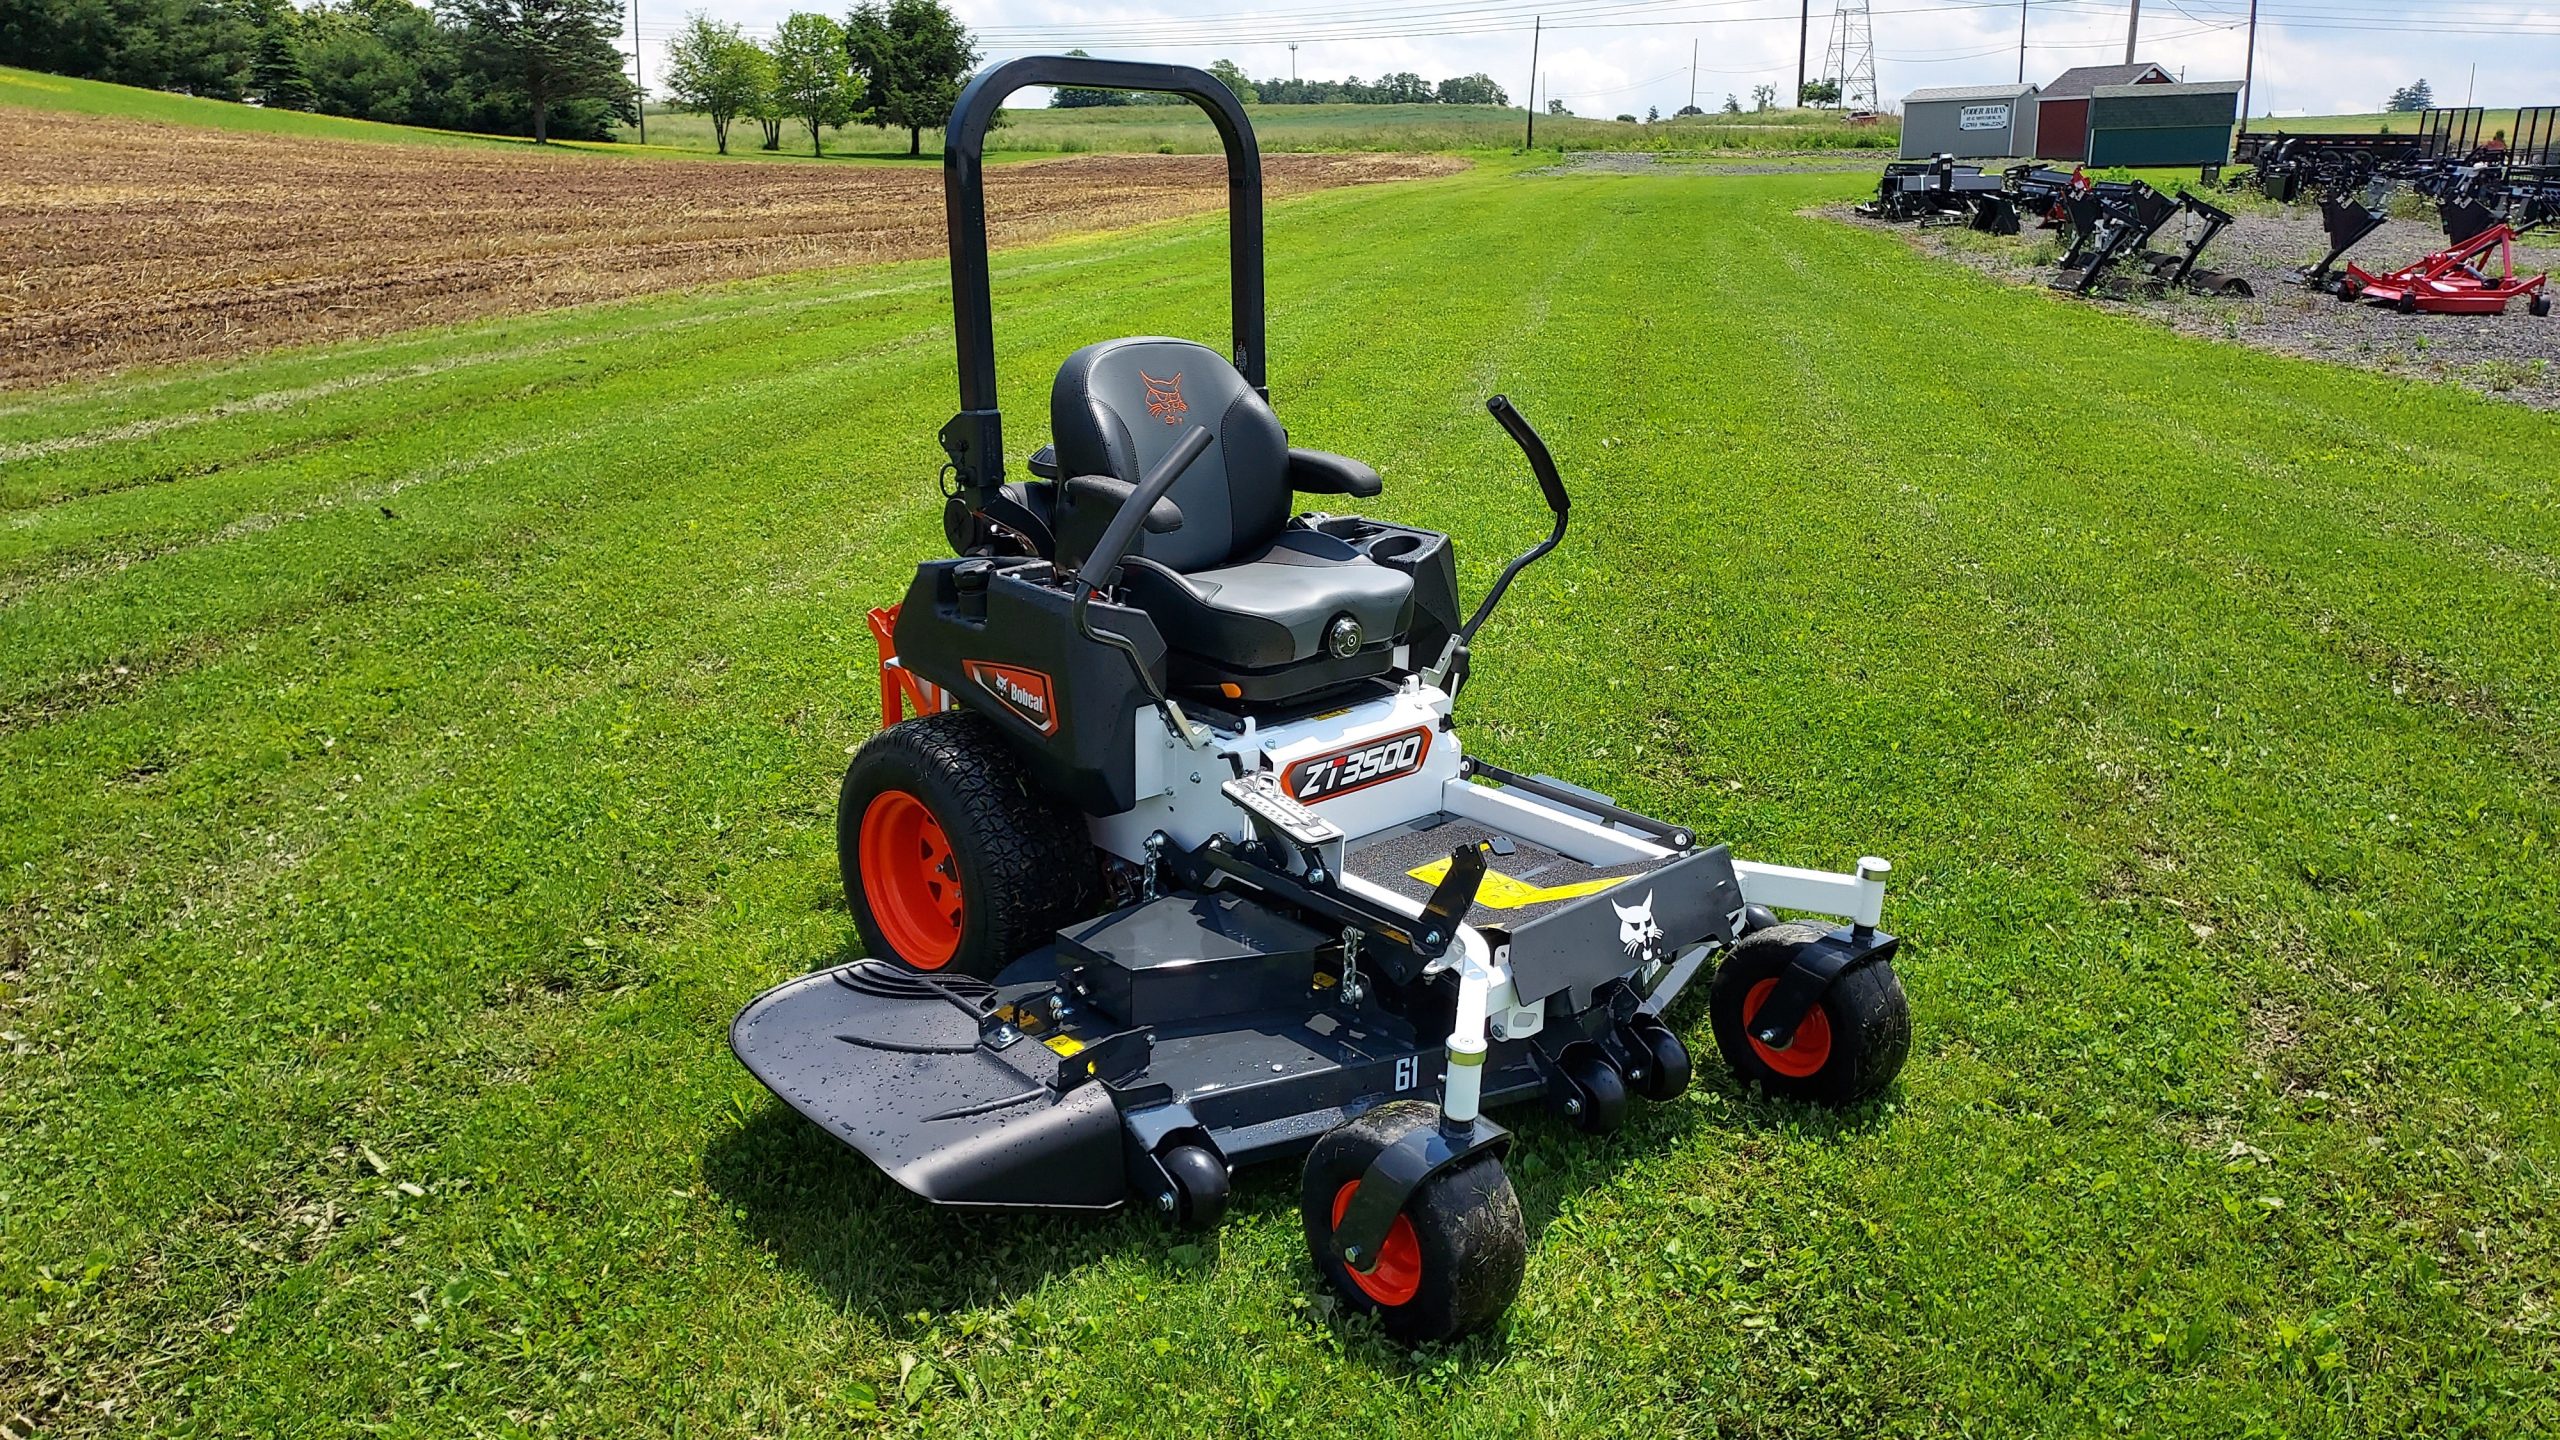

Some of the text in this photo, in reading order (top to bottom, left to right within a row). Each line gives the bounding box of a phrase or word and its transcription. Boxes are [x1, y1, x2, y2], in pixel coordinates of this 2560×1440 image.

[1011, 683, 1043, 712] Bobcat
[1299, 735, 1421, 798] ZT3500
[1395, 1055, 1418, 1091] 61
